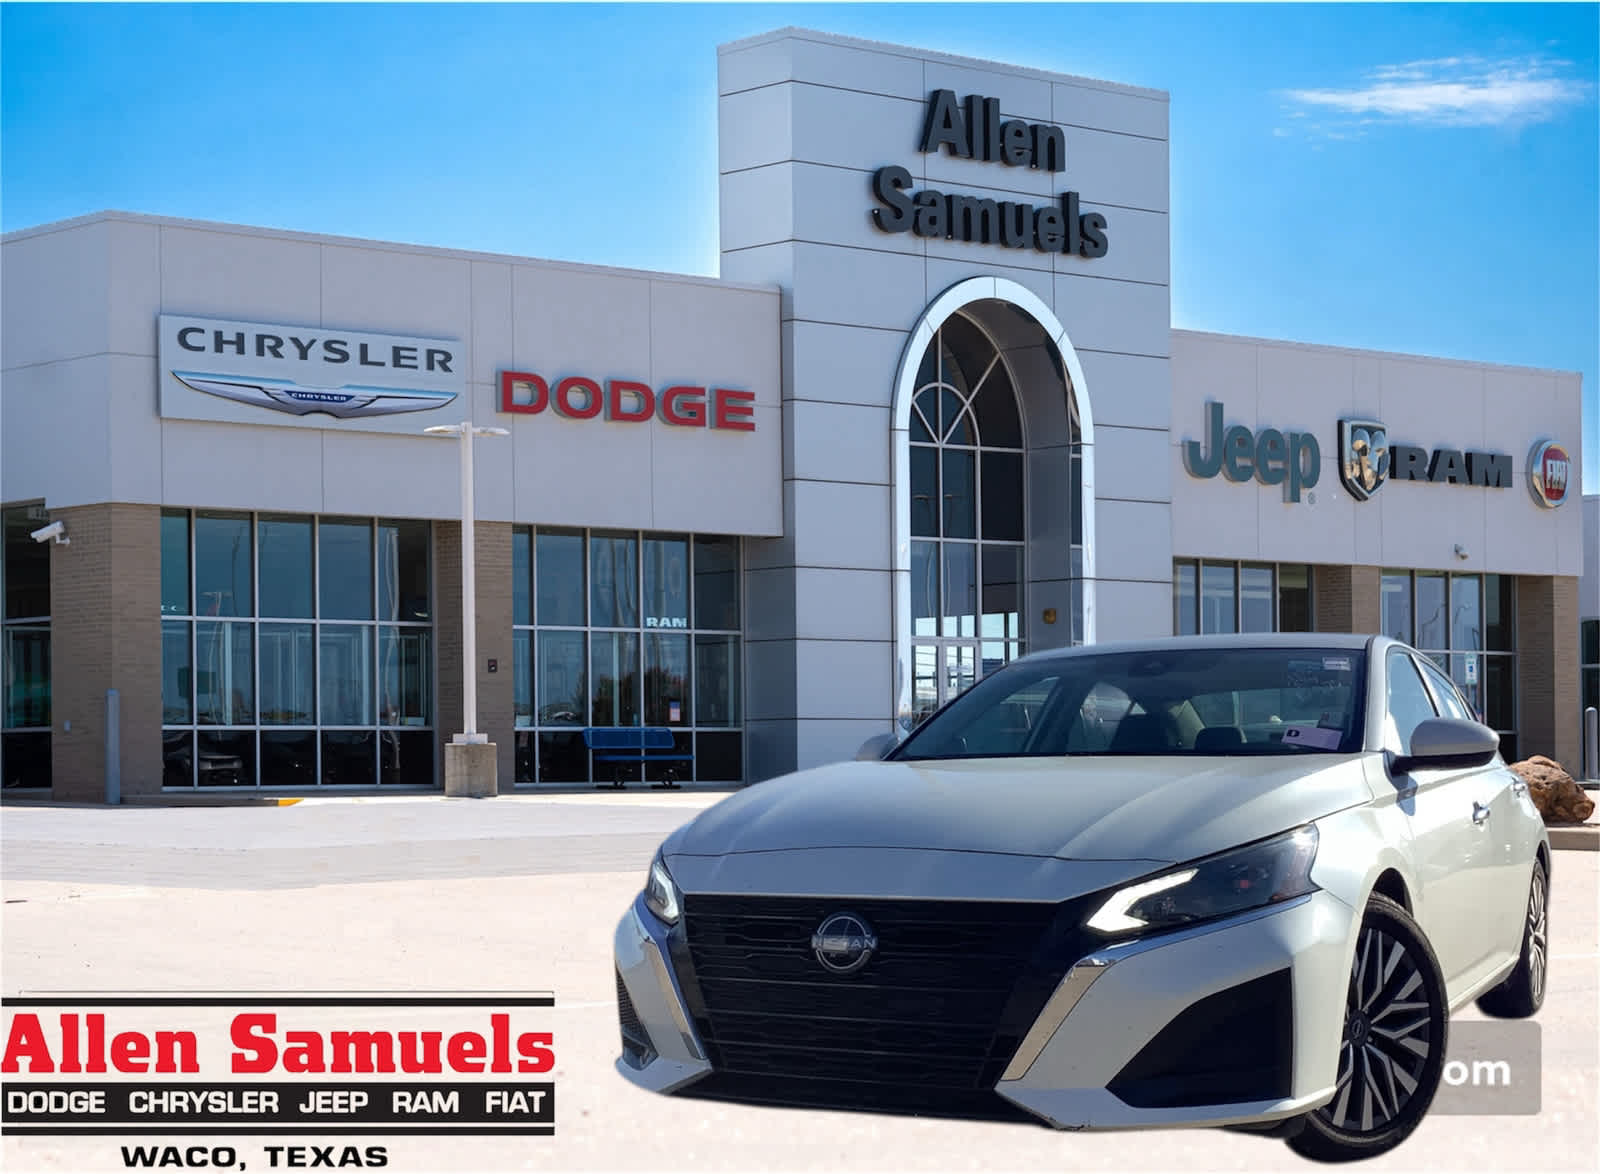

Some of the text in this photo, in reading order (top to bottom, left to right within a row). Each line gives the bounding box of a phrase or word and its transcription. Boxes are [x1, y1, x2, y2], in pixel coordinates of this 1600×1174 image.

[919, 89, 1066, 172] Allen
[872, 165, 1108, 258] Samuels
[177, 326, 454, 373] CHRYSLER
[496, 371, 756, 432] DODGE
[1183, 401, 1321, 503] Jeep
[1388, 445, 1513, 488] RAM
[646, 617, 687, 628] RAM
